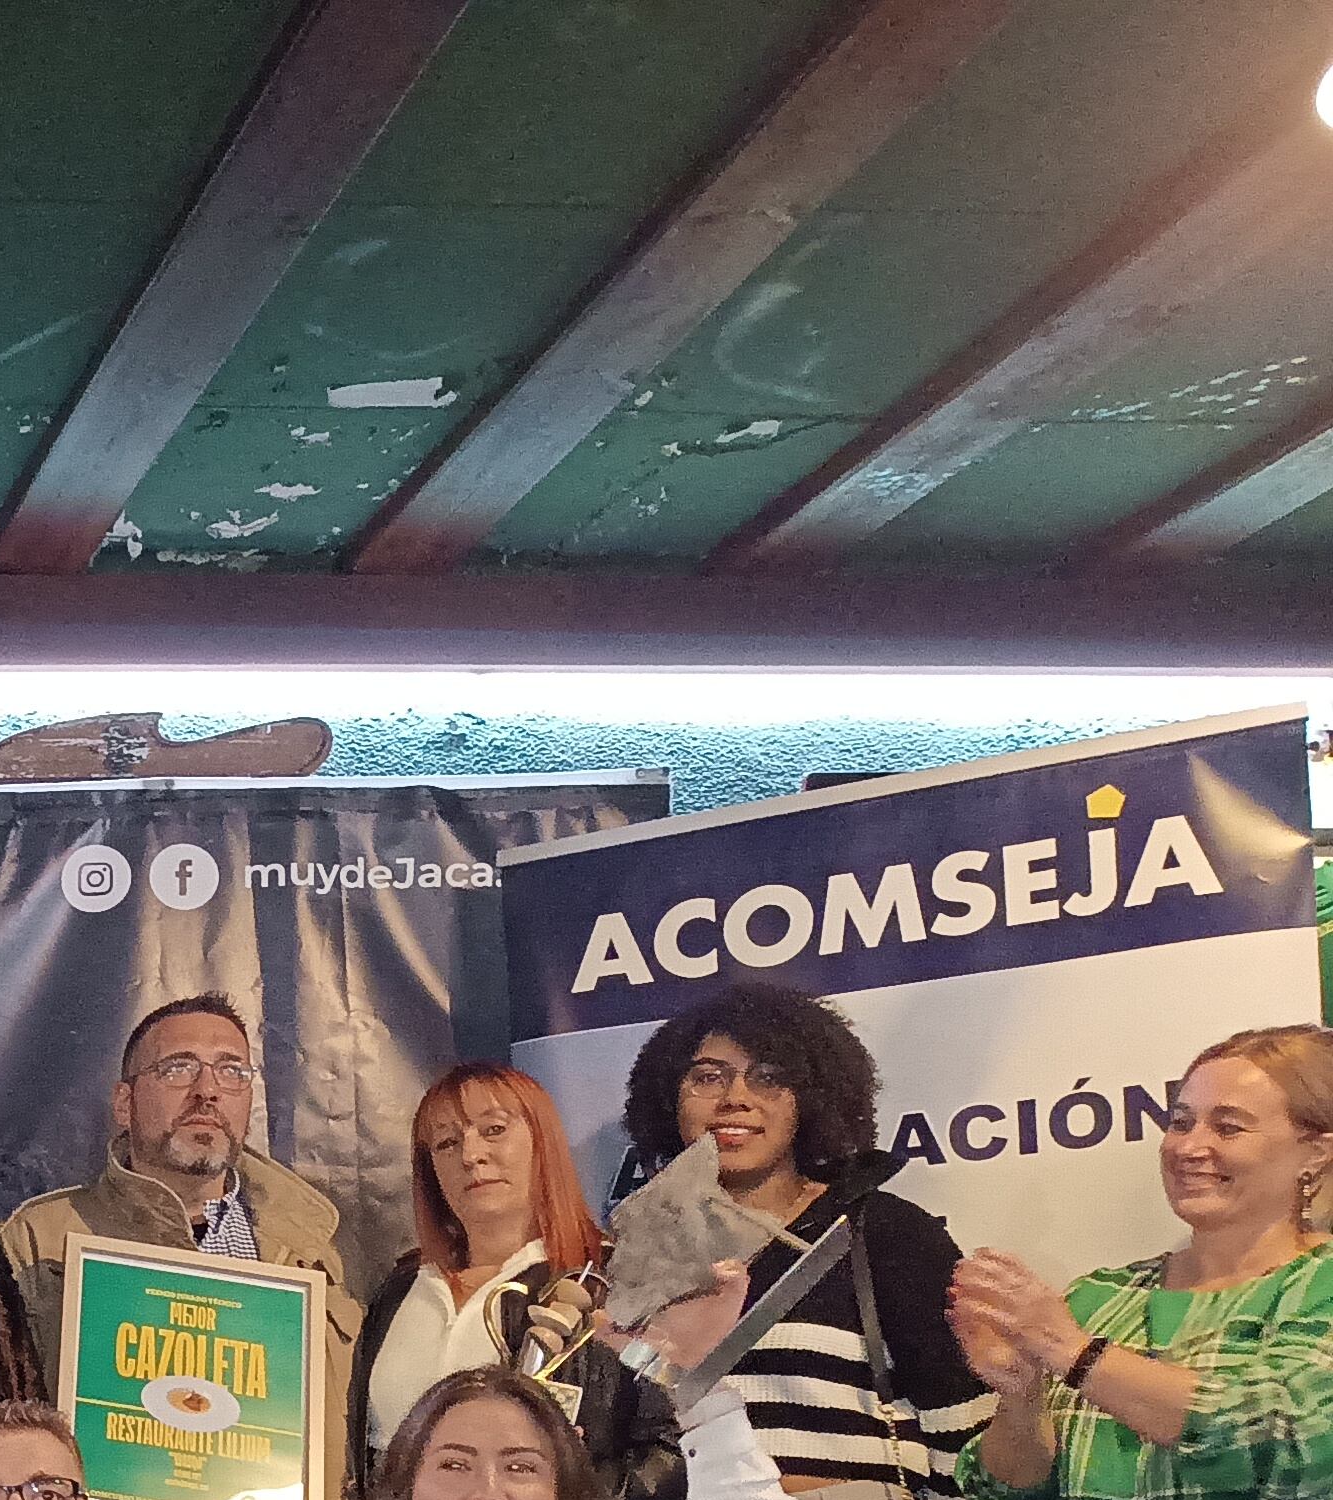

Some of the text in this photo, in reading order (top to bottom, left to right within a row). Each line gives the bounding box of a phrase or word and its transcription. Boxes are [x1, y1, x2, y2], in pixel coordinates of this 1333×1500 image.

[570, 784, 1224, 994] ACOMSEJA
[890, 1076, 1189, 1166] ACIÓN
[170, 1301, 217, 1331] MEJOR
[115, 1322, 268, 1400] CAZOLETA
[106, 1411, 214, 1455] RESTAURANTE
